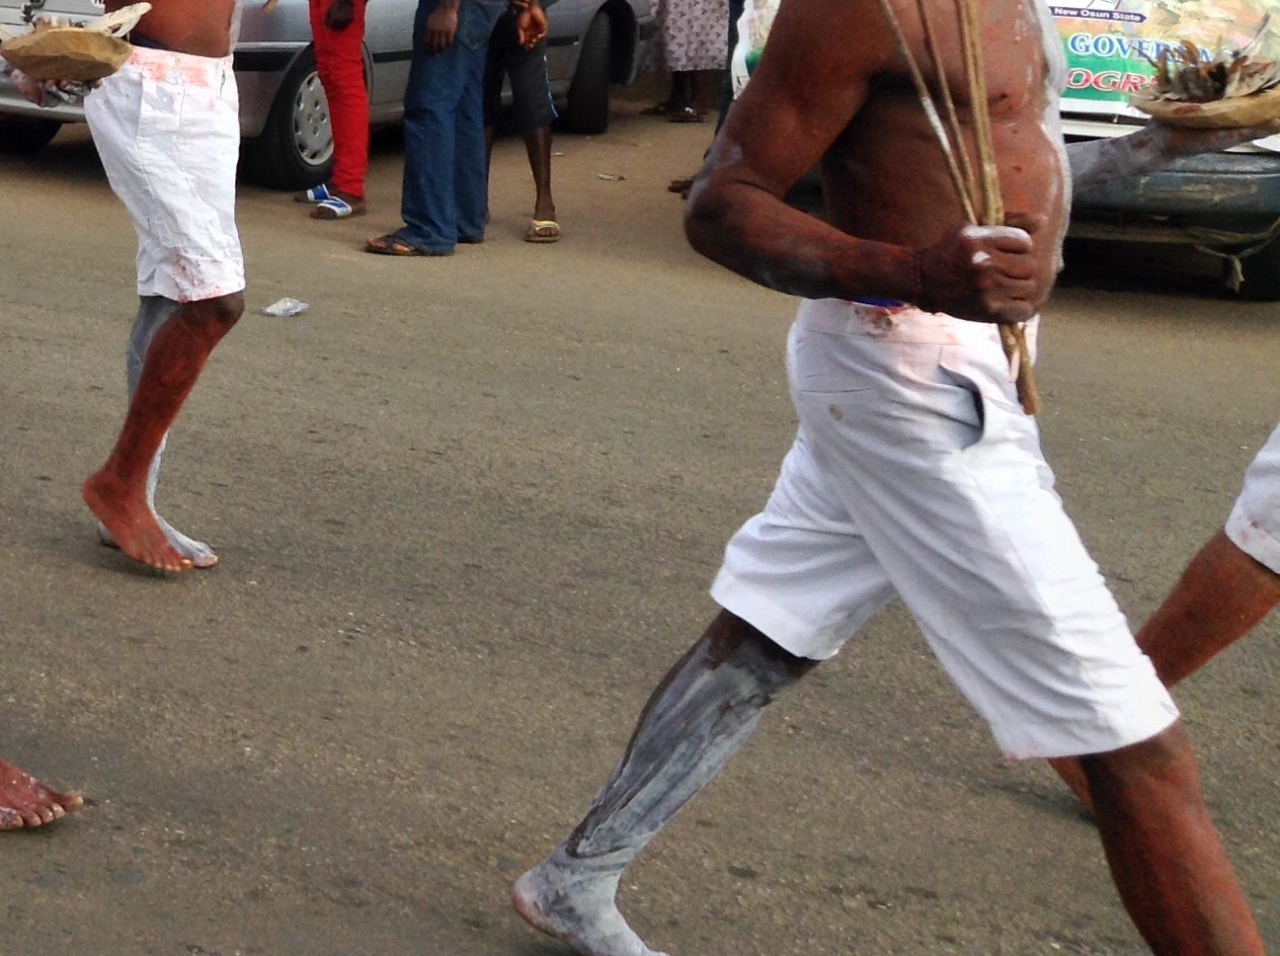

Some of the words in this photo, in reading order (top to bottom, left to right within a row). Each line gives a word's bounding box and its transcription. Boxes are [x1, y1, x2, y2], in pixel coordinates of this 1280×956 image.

[1054, 7, 1079, 16] New
[1080, 10, 1111, 19] Osun
[1112, 11, 1142, 22] State
